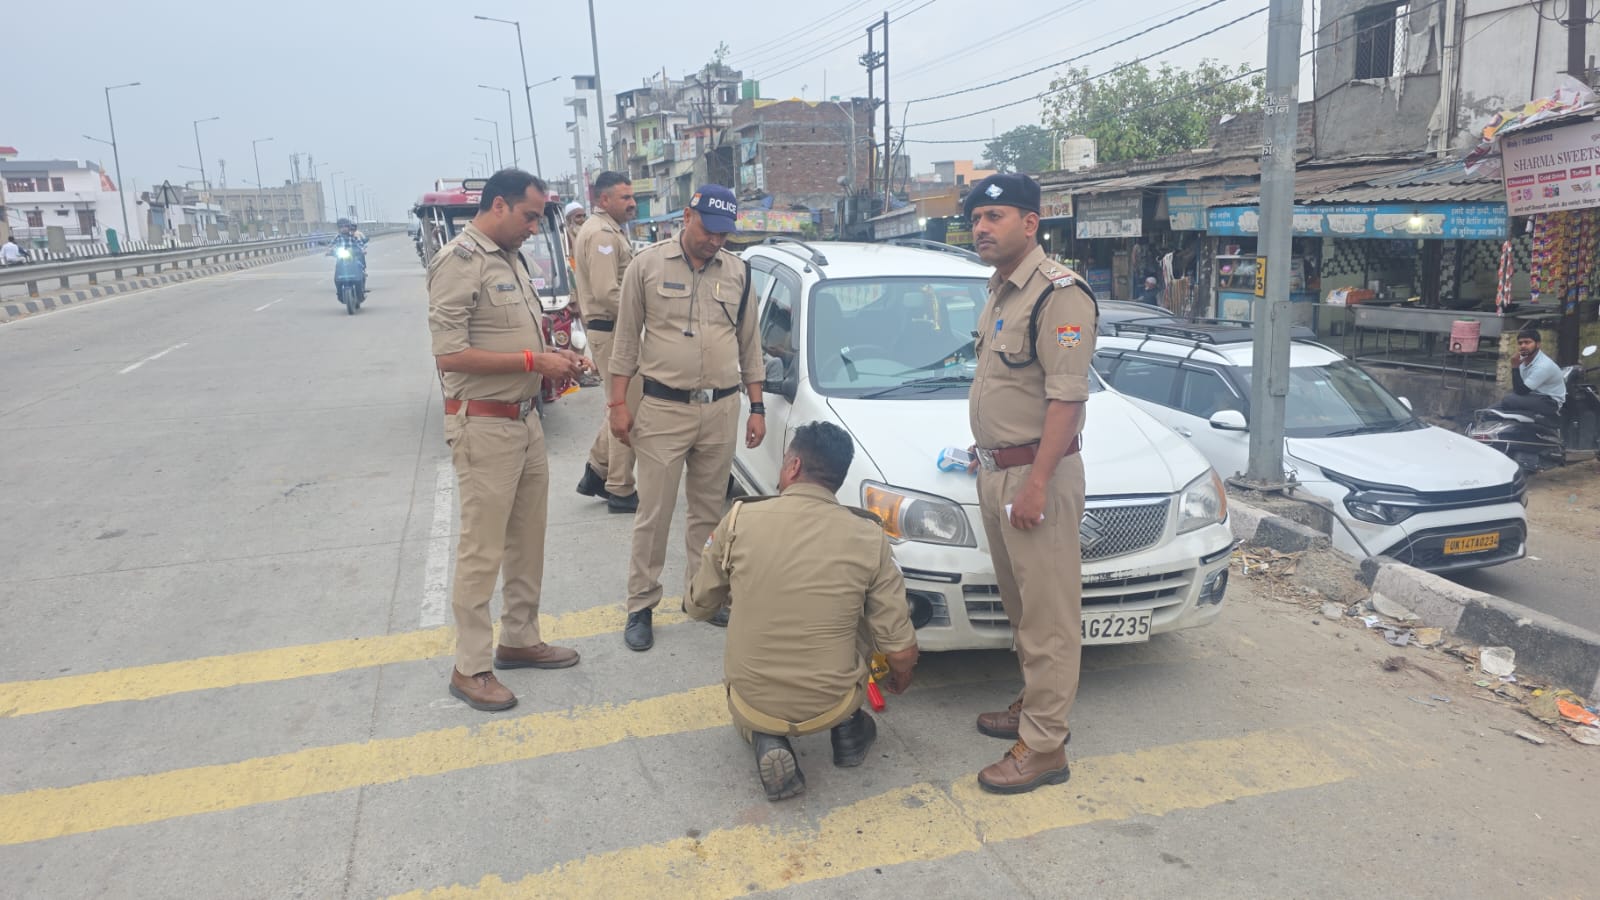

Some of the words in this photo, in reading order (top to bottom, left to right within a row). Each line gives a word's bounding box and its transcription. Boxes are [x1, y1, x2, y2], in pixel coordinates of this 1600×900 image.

[1514, 154, 1556, 171] SHARMA
[1558, 146, 1600, 164] SWEETS
[708, 198, 736, 214] POLICE
